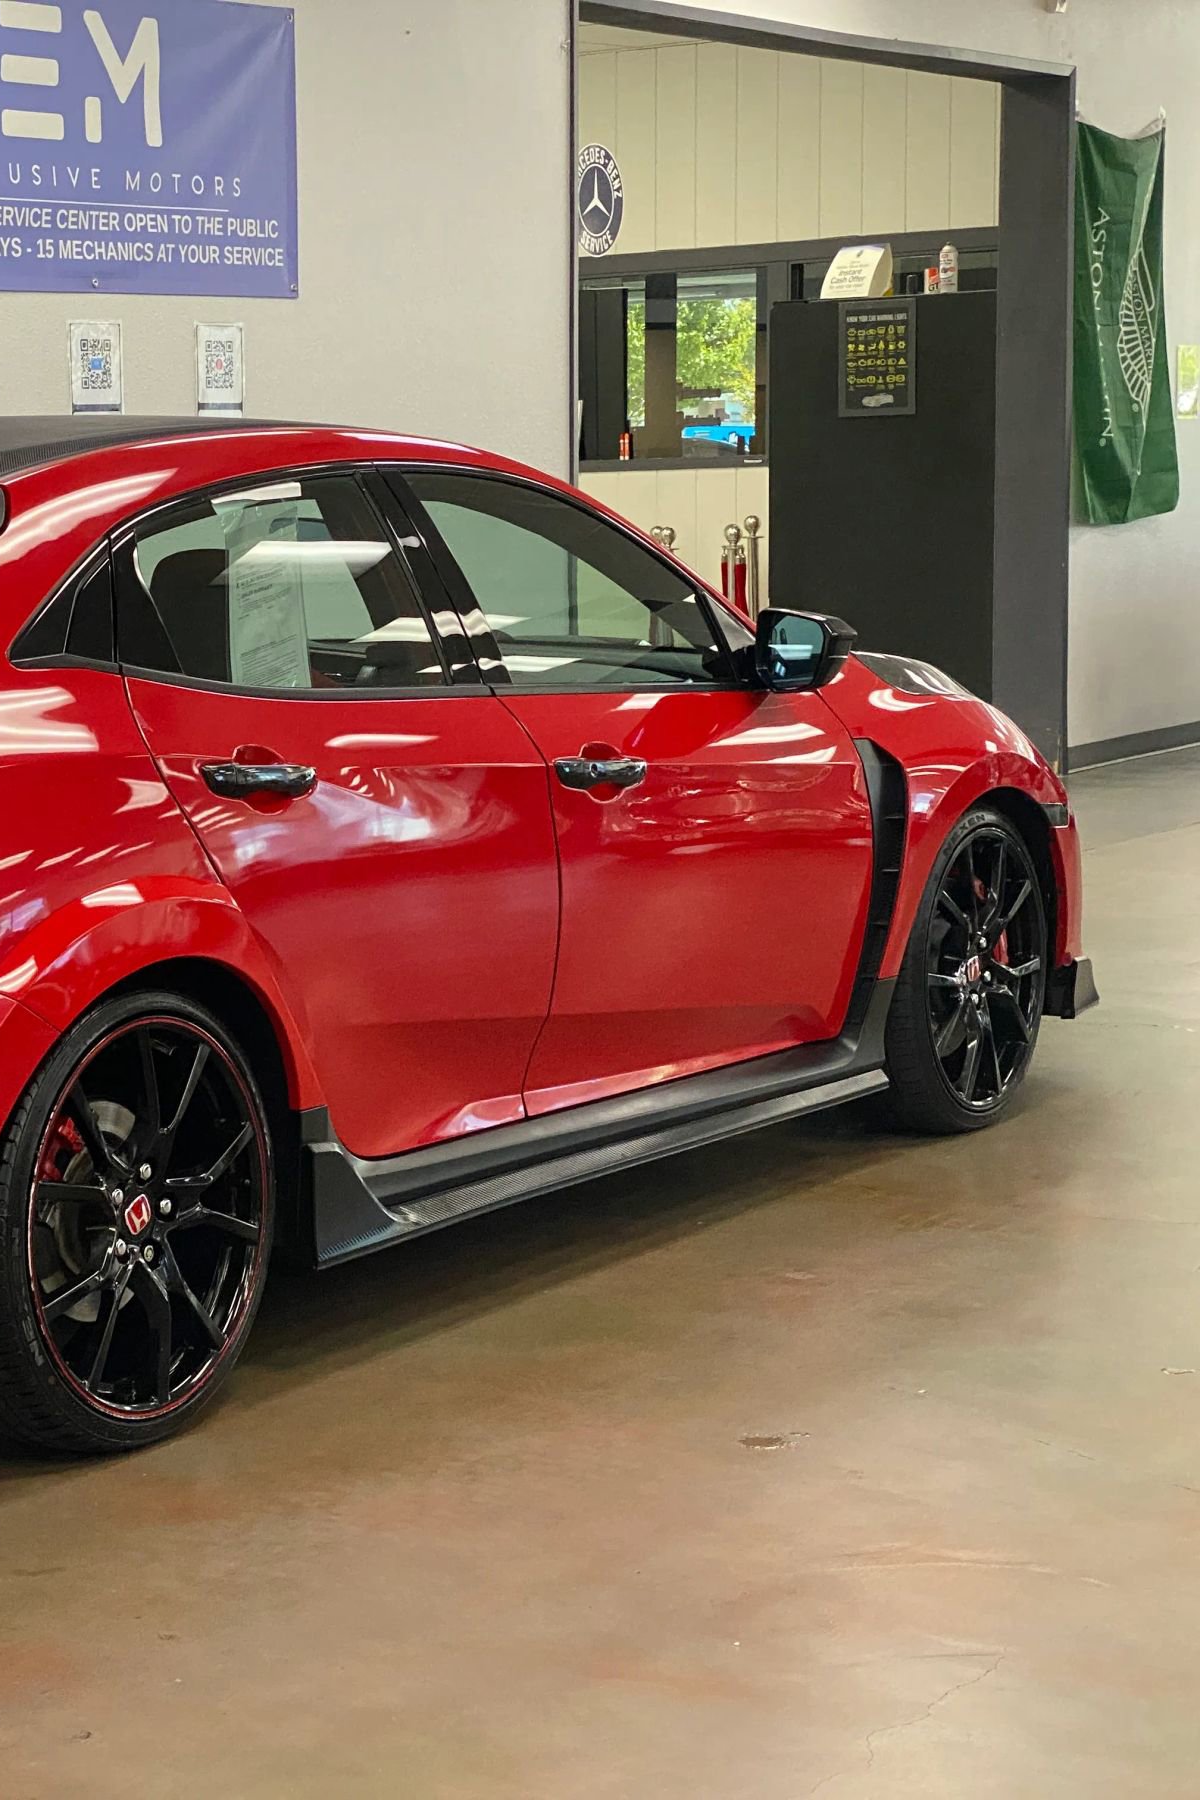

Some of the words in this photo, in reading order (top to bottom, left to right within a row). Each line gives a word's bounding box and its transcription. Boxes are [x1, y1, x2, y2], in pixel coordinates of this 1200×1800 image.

[126, 171, 242, 197] MOTORS
[578, 147, 622, 199] CEDES-BENZ
[56, 209, 120, 232] CENTER
[124, 212, 169, 234] OPEN
[172, 214, 192, 235] TO
[196, 216, 224, 236] THE
[227, 217, 279, 239] PUBLIC
[36, 239, 54, 259] 15
[58, 240, 154, 263] MECHANICS
[157, 244, 178, 264] AT
[178, 244, 220, 265] YOUR
[224, 246, 284, 267] SERVICE
[580, 230, 613, 253] SERVICE
[1091, 206, 1111, 312] ASTON
[943, 814, 986, 857] NEXEN
